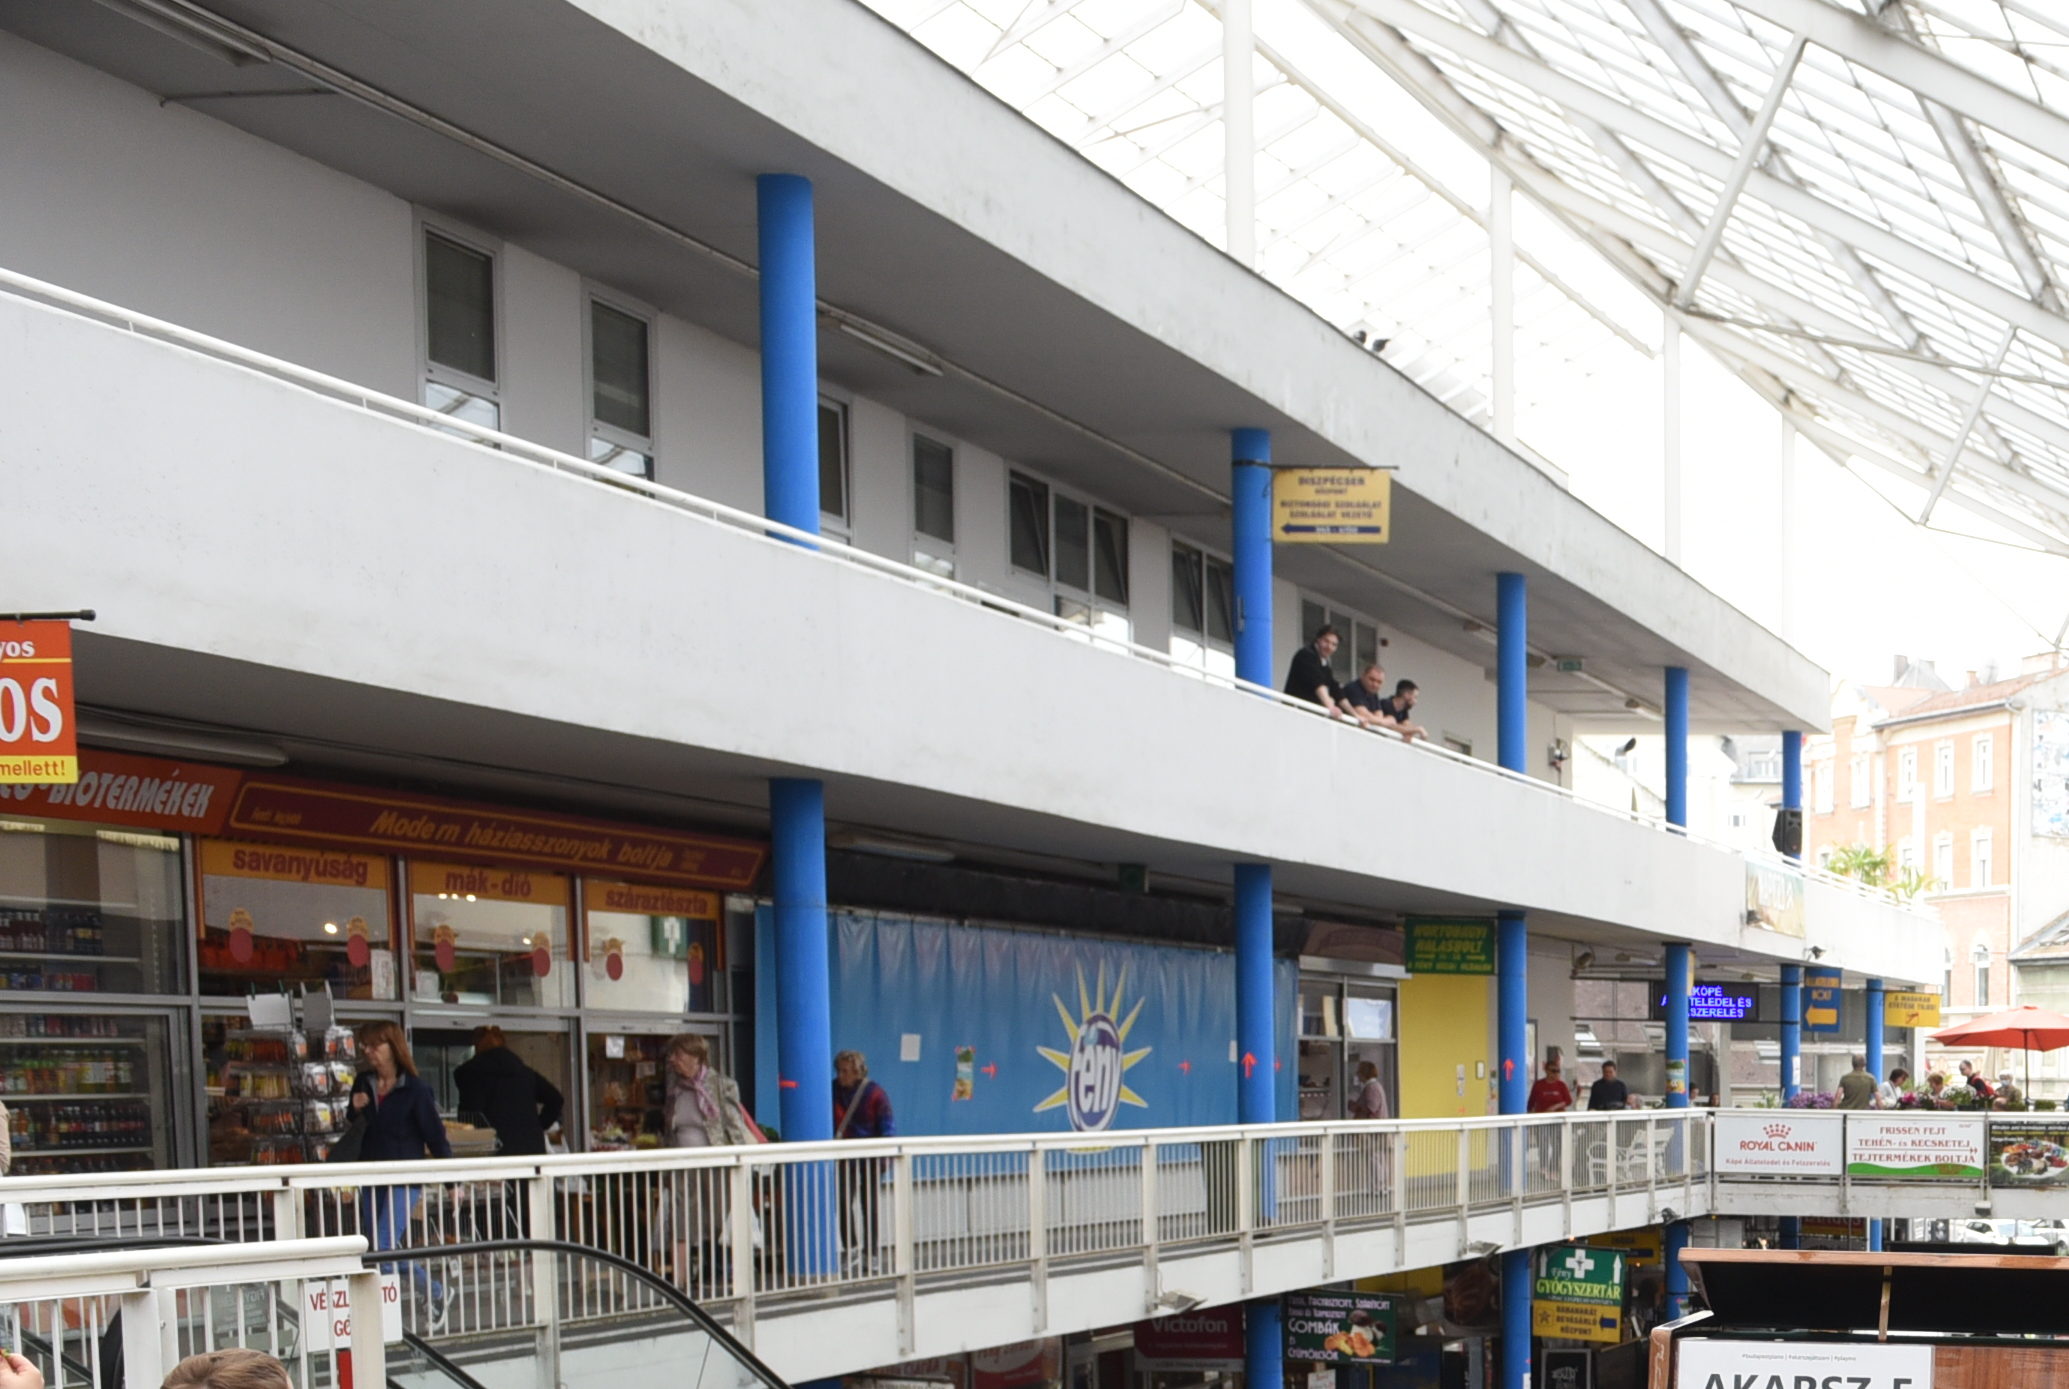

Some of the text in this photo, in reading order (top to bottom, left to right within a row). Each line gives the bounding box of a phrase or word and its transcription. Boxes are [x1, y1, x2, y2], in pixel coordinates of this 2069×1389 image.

[464, 821, 614, 862] háziasszonyok
[616, 842, 674, 867] boltja
[232, 848, 369, 886] savanyúság
[605, 886, 709, 914] száraztészta
[1811, 989, 1832, 1000] BOLT
[1737, 996, 1752, 1008] ÉS
[1879, 1126, 1947, 1135] FRISSEN FEJT
[1740, 1140, 1815, 1152] ROYAL CANIN
[1911, 1139, 1970, 1148] KECSKETEJ
[1726, 1157, 1742, 1167] Kópé
[1744, 1157, 1780, 1166] Állateledel
[1792, 1158, 1831, 1167] Felszerelés
[1852, 1151, 1976, 1164] TEJTERMÉKEK BOLTJA
[1536, 1277, 1621, 1299] GYÓGYSZERTÁR
[1151, 1315, 1229, 1333] Victofon
